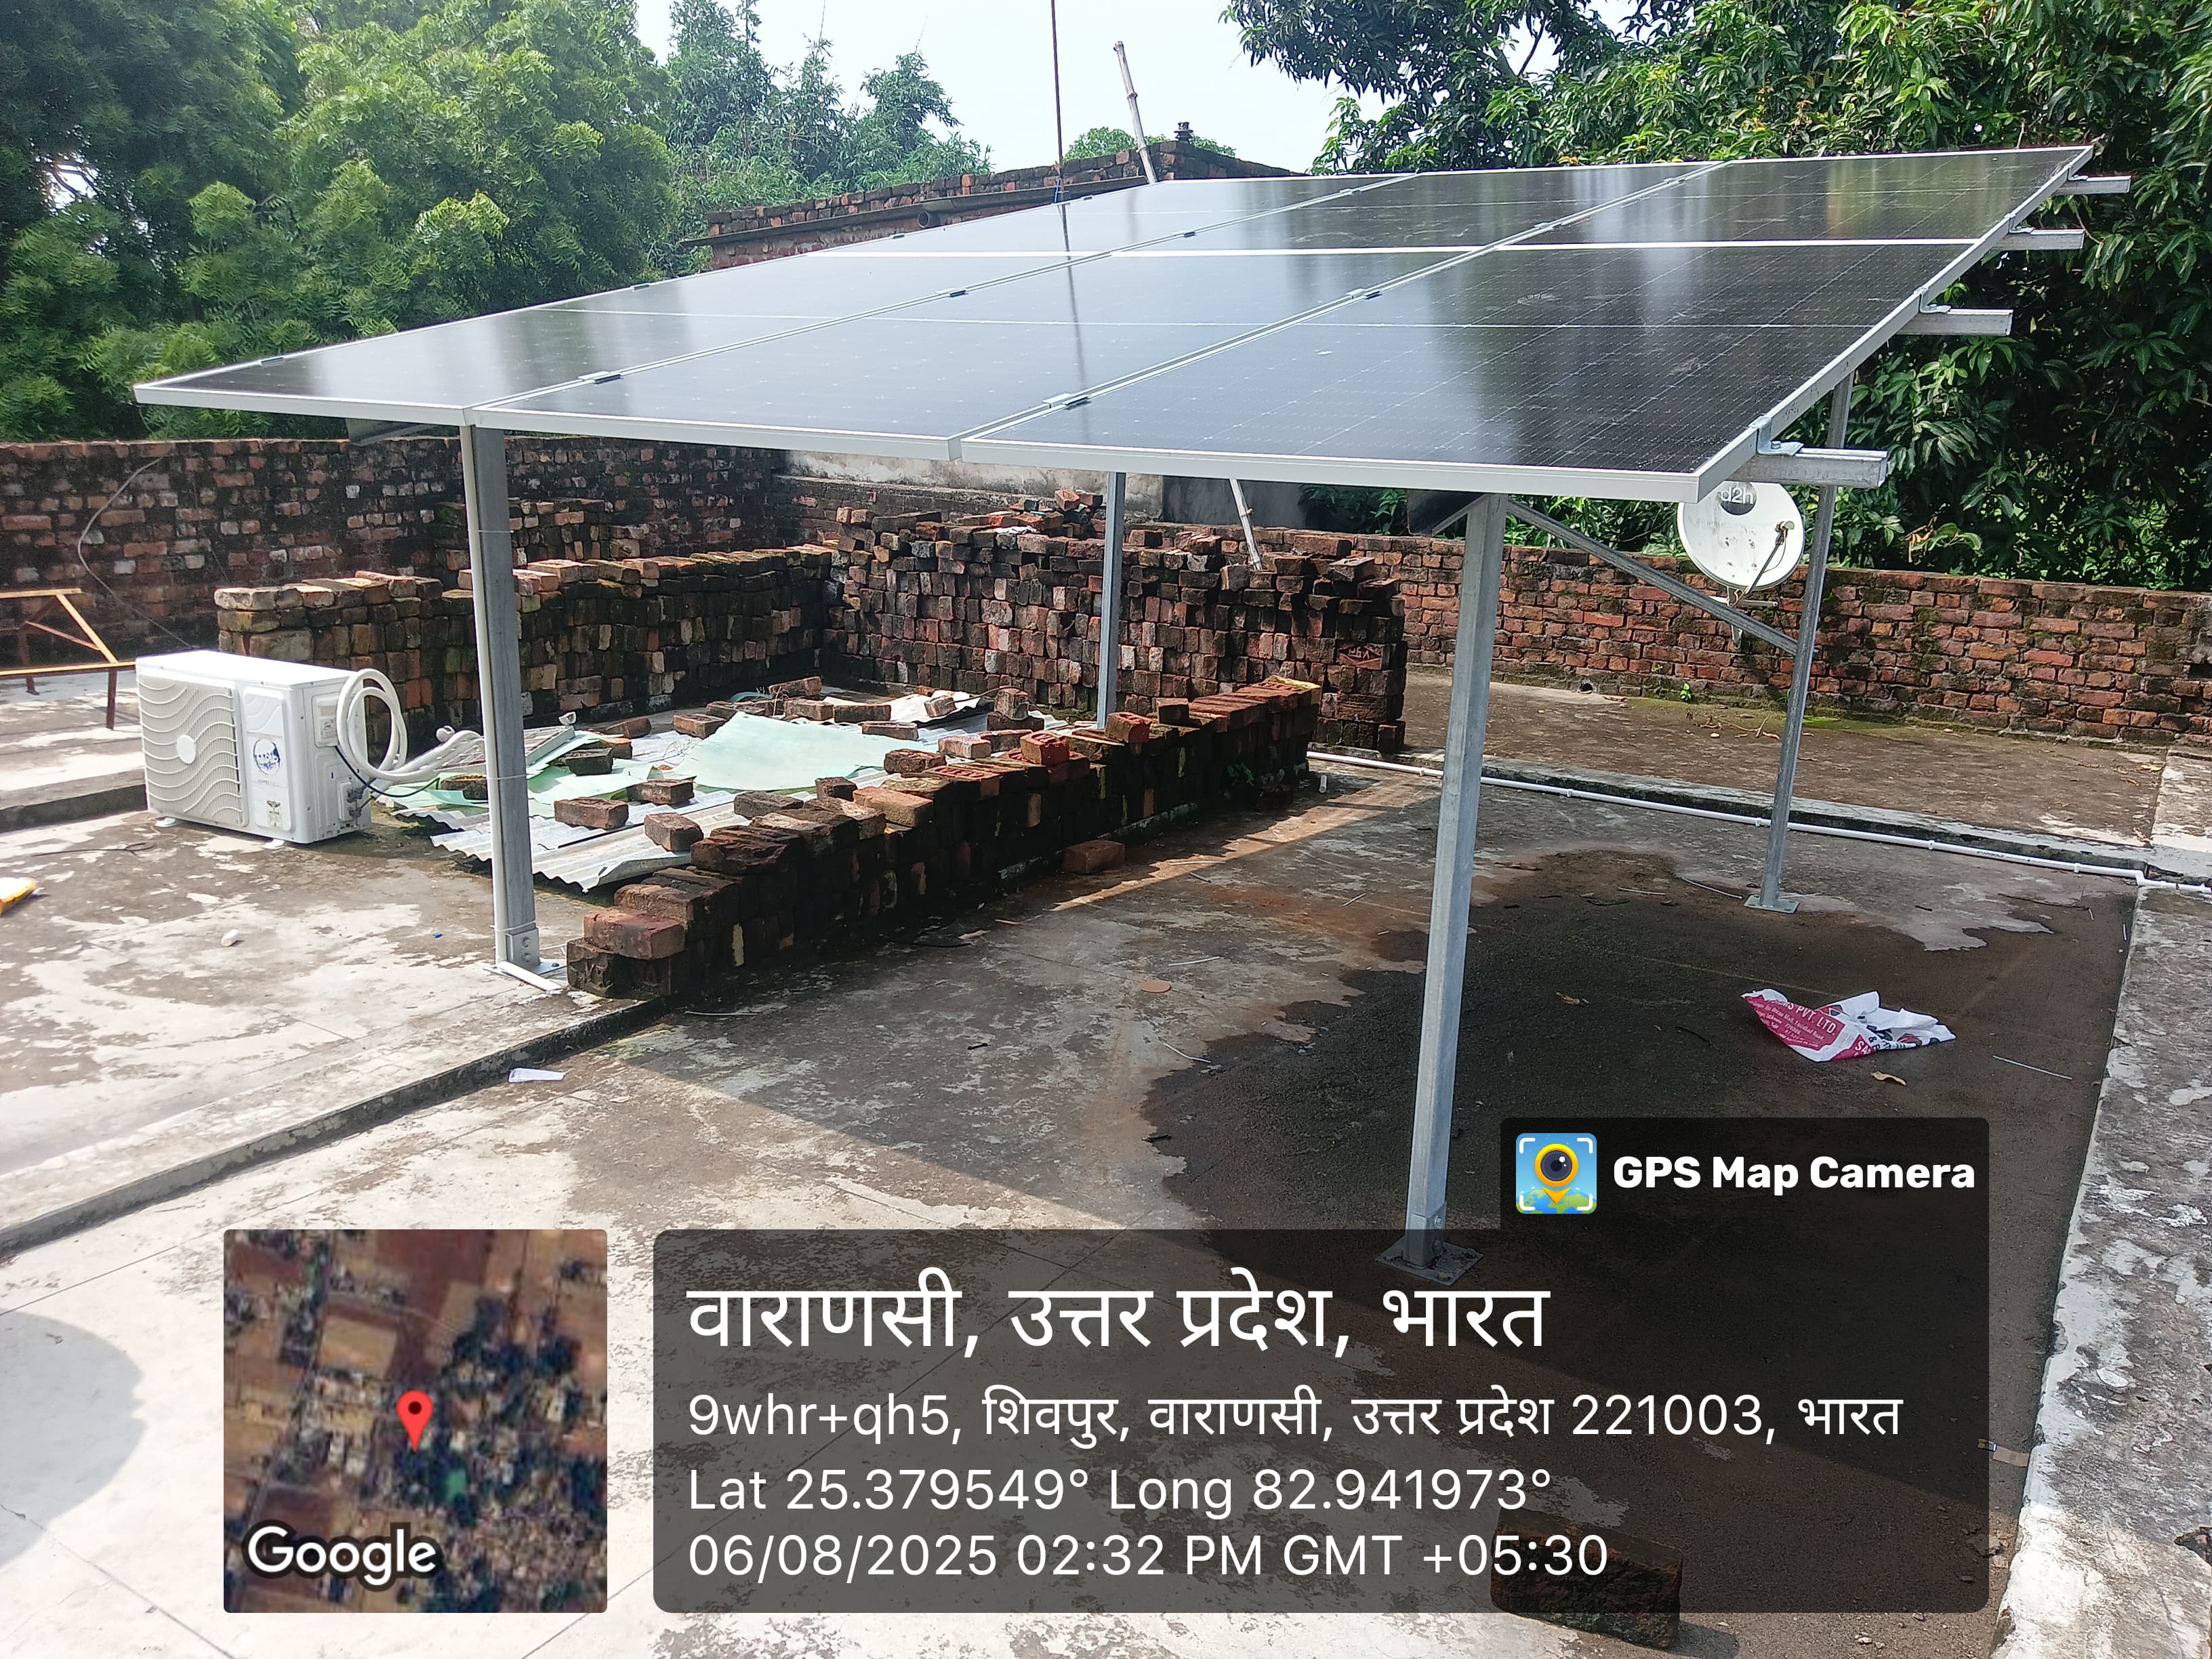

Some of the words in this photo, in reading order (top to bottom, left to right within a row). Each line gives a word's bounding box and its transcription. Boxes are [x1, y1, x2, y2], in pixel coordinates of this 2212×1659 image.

[1721, 487, 1753, 504] d2h
[1795, 1006, 1816, 1023] PVT.
[1817, 1017, 1835, 1036] LTD.
